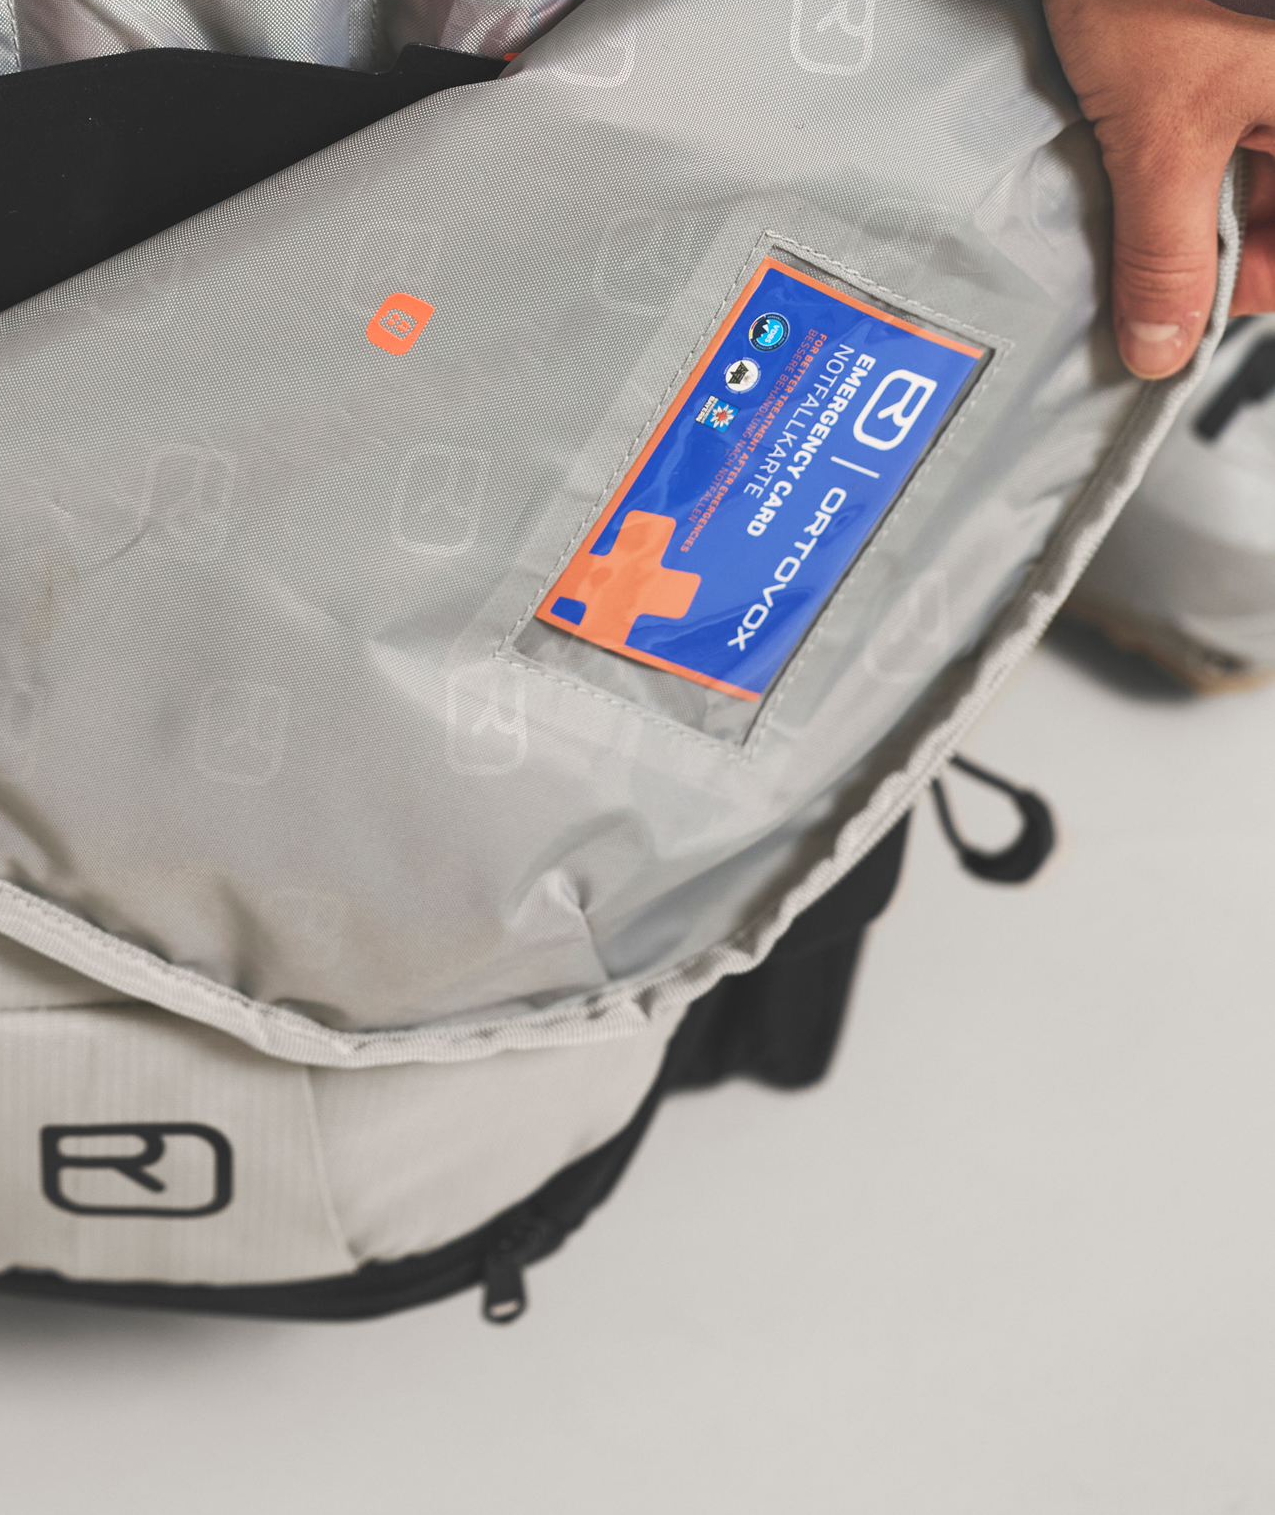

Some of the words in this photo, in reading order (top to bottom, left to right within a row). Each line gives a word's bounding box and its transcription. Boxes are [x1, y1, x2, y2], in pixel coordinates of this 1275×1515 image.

[764, 323, 780, 344] VDBS
[785, 329, 817, 373] BESSERE
[810, 334, 827, 354] FOR
[785, 355, 814, 393] BETTER
[743, 374, 788, 438] BEHANDLUNG
[744, 345, 854, 497] NOTFALLKARTE
[747, 395, 788, 453] TREATMENT
[787, 354, 875, 479] EMERGENCY
[724, 452, 749, 485] AFTER
[725, 440, 746, 466] NACH
[680, 485, 728, 552] EMERGENCIES
[747, 481, 792, 536] CARD
[728, 488, 846, 649] ORTOVOX
